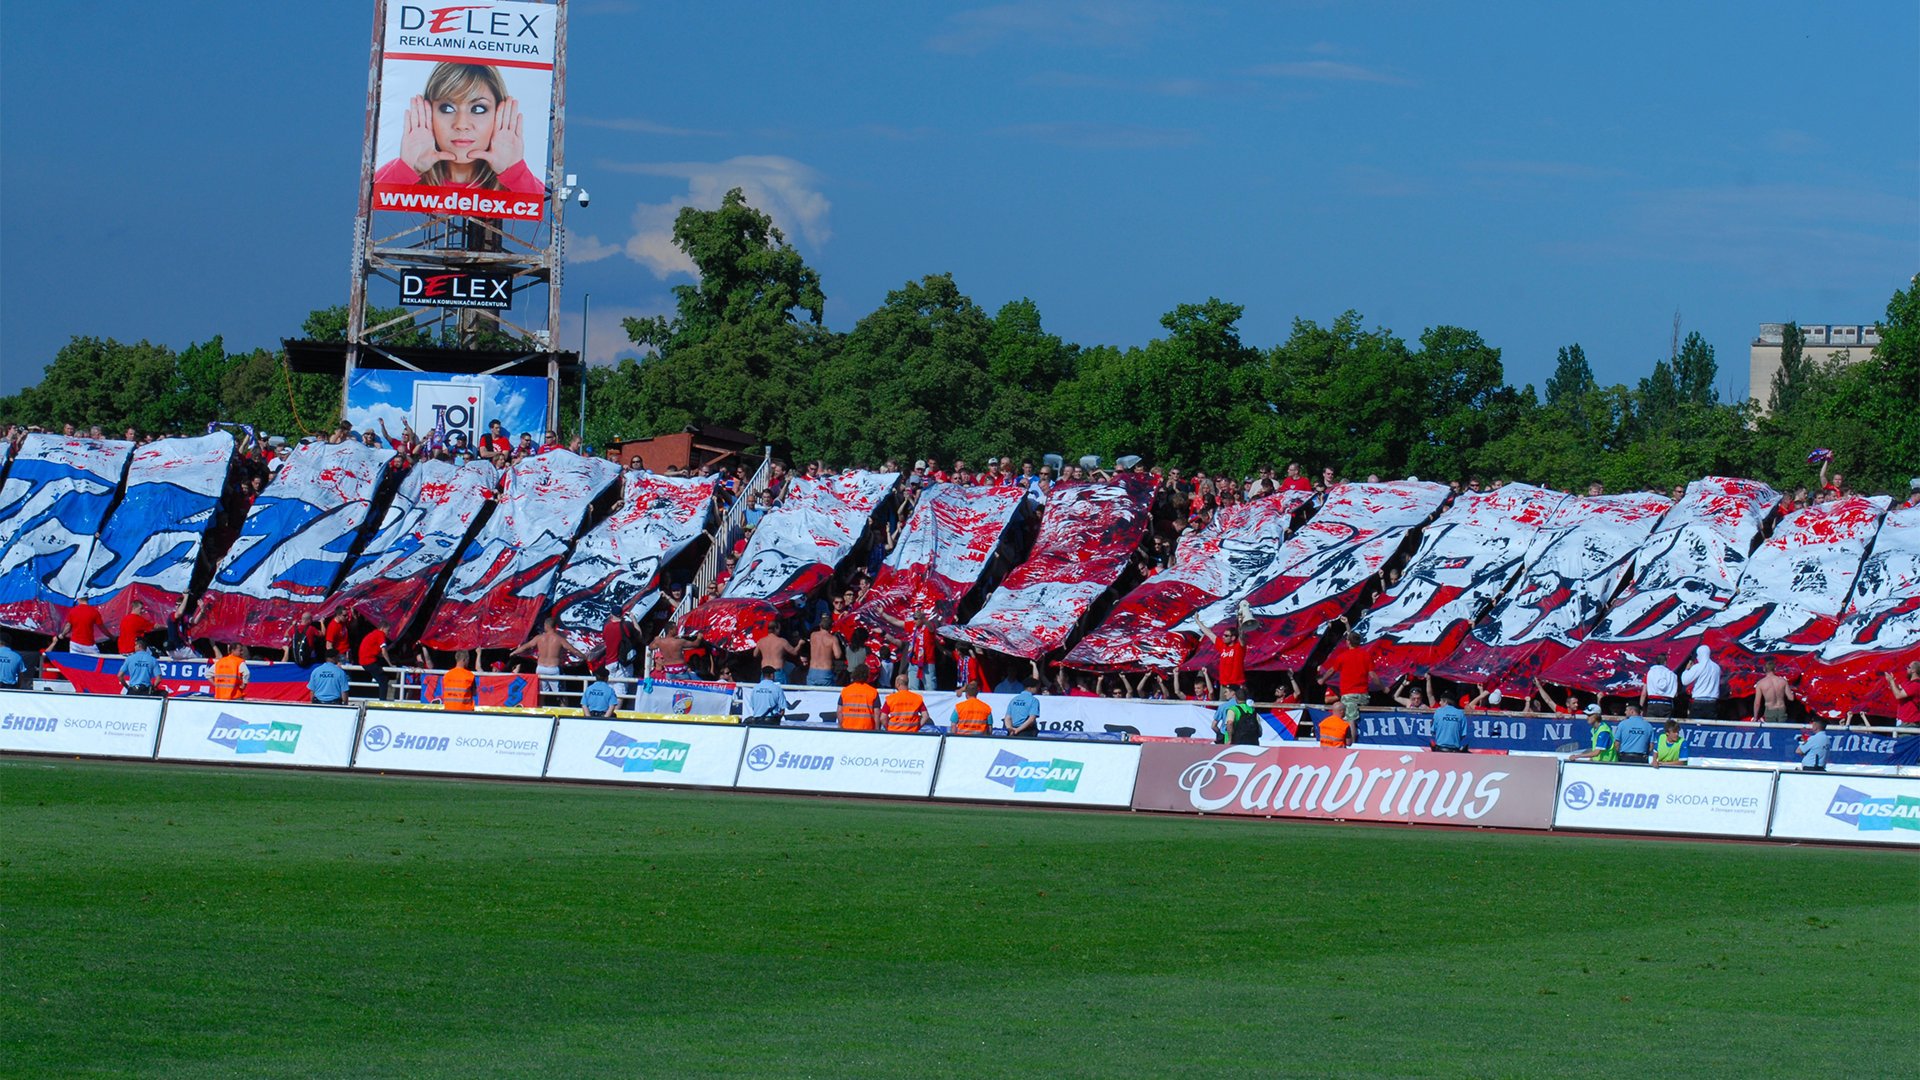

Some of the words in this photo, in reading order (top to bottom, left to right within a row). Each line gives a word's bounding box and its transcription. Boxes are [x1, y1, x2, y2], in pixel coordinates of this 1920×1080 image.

[400, 5, 540, 39] DELEX
[399, 35, 466, 49] REKLAMNÍ
[469, 40, 539, 55] AGENTURA
[380, 191, 539, 217] www.delex.cz
[403, 274, 508, 299] DELEX
[431, 404, 475, 429] TOI
[158, 663, 209, 678] RIGA
[1, 713, 58, 732] ŠKODA
[63, 717, 102, 730] ŠKODA
[105, 720, 148, 732] POWER
[1358, 717, 1434, 737] EART
[1472, 720, 1527, 740] OUR
[1541, 723, 1573, 741] IN
[210, 727, 300, 743] DOOSAN
[392, 731, 450, 752] ŠKODA
[455, 736, 494, 748] ŠKODA
[496, 739, 539, 750] POWER
[600, 744, 688, 762] DOOSAN
[775, 750, 835, 771] ŠKODA
[840, 755, 879, 767] ŠKODA
[882, 757, 925, 769] POWER
[989, 764, 1080, 782] DOOSAN
[1178, 745, 1509, 820] Gambrinus
[1596, 788, 1660, 810] ŠKODA
[1665, 793, 1709, 805] ŠKODA
[1711, 796, 1759, 808] POWER
